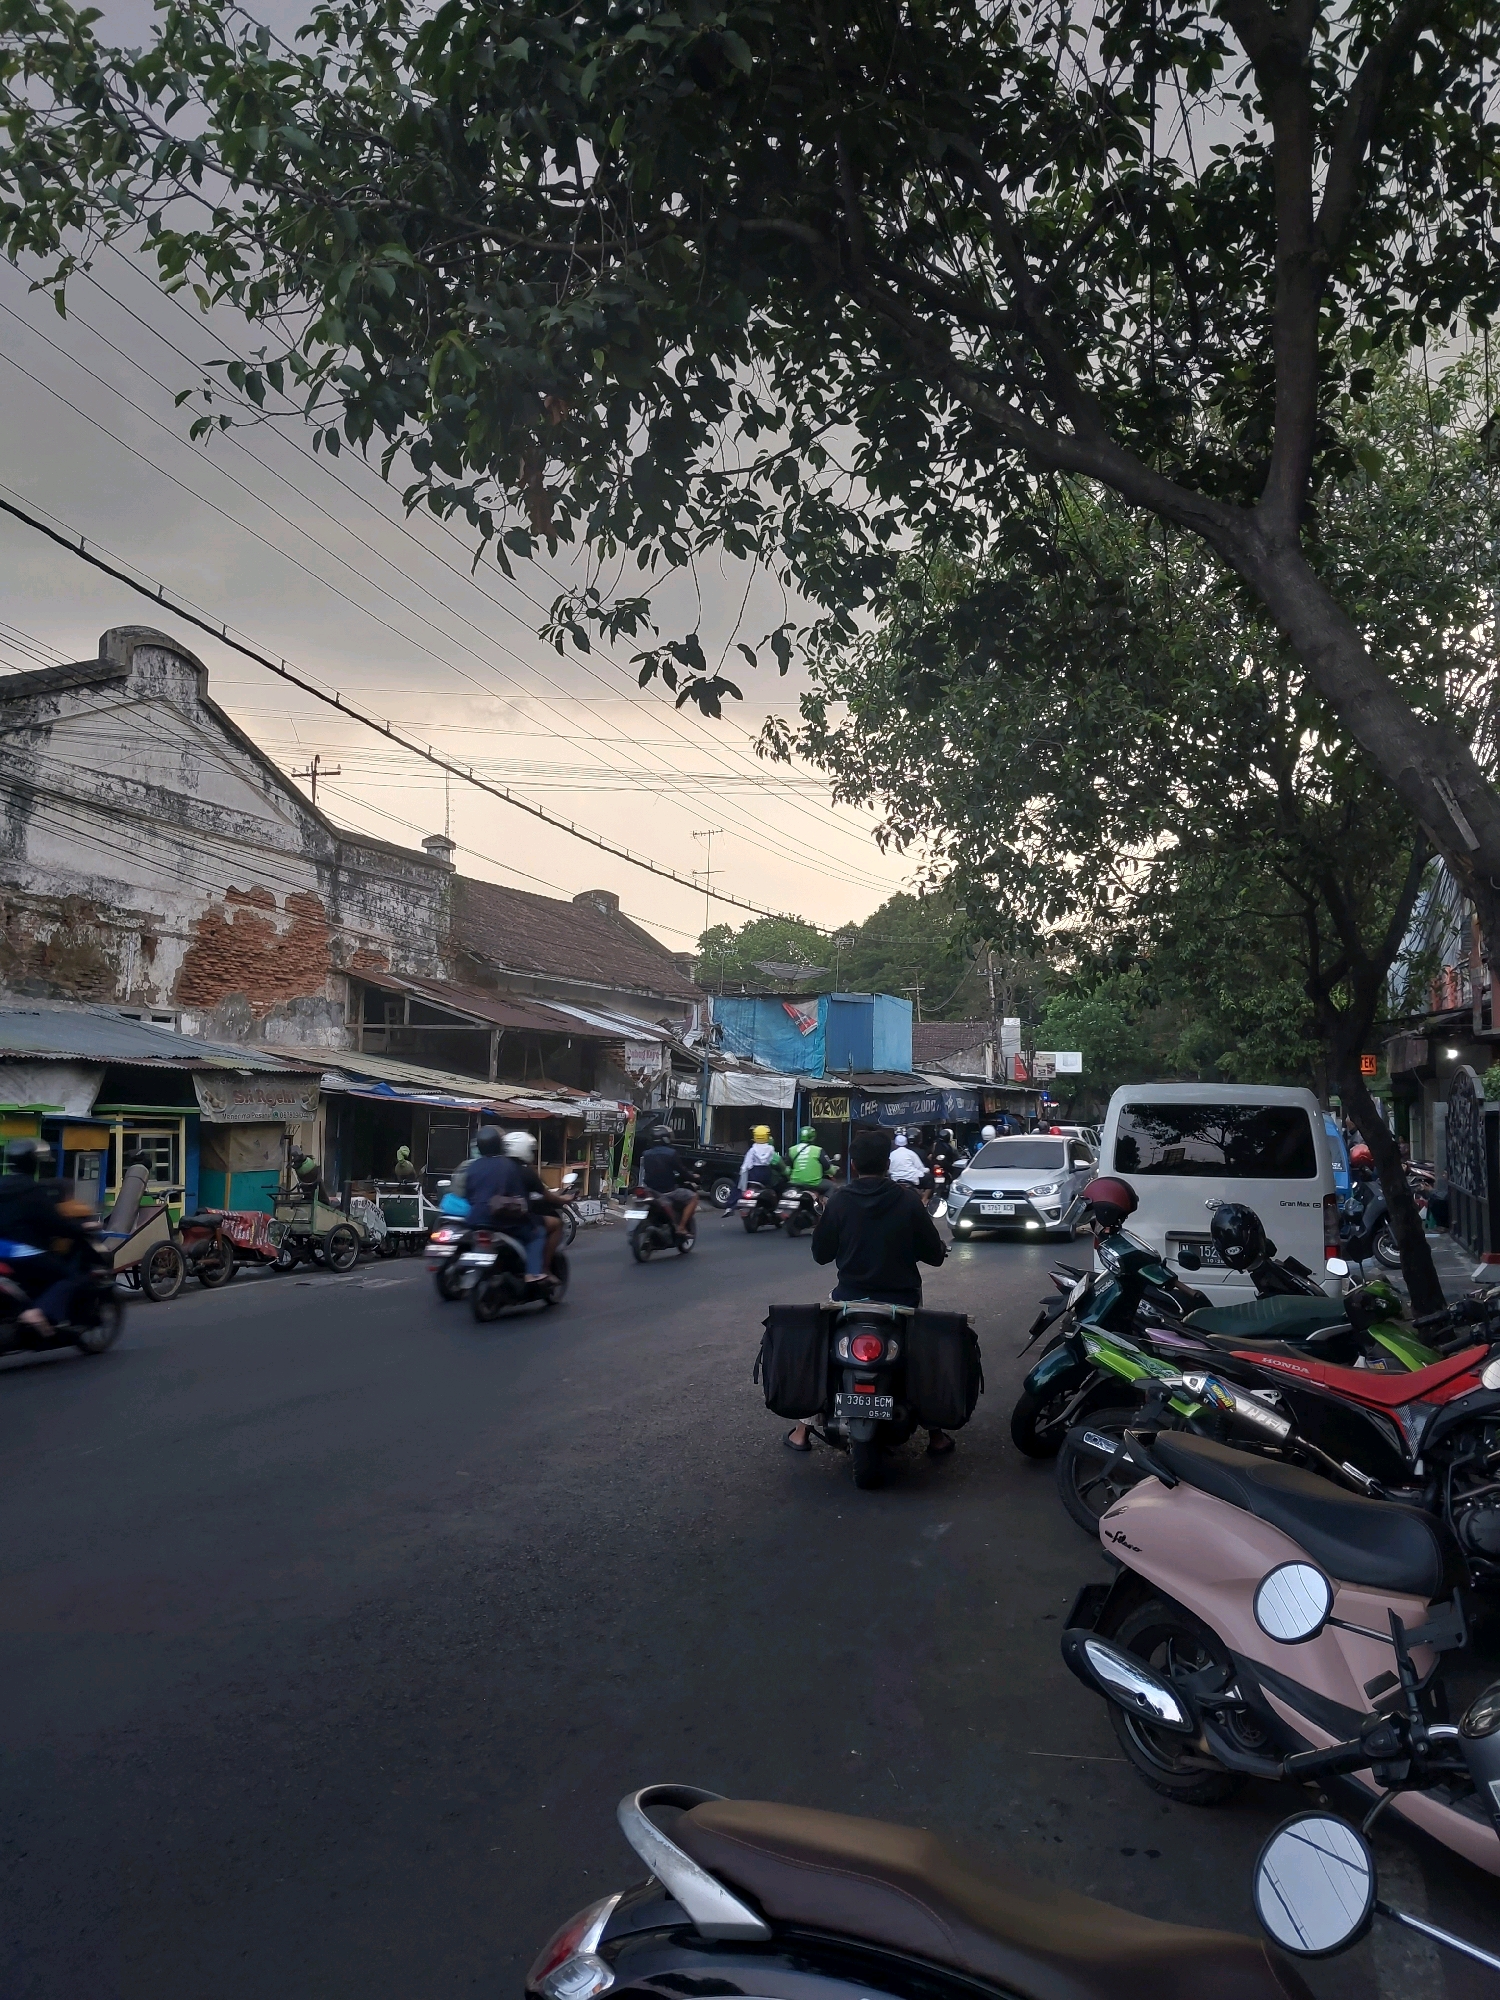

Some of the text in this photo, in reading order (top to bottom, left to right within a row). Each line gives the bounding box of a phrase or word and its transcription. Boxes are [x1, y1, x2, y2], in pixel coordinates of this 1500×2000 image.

[1297, 1200, 1311, 1208] Max
[1199, 1245, 1221, 1258] 152
[1261, 1357, 1311, 1375] HONDA
[835, 1394, 893, 1408] N 3363 ECM
